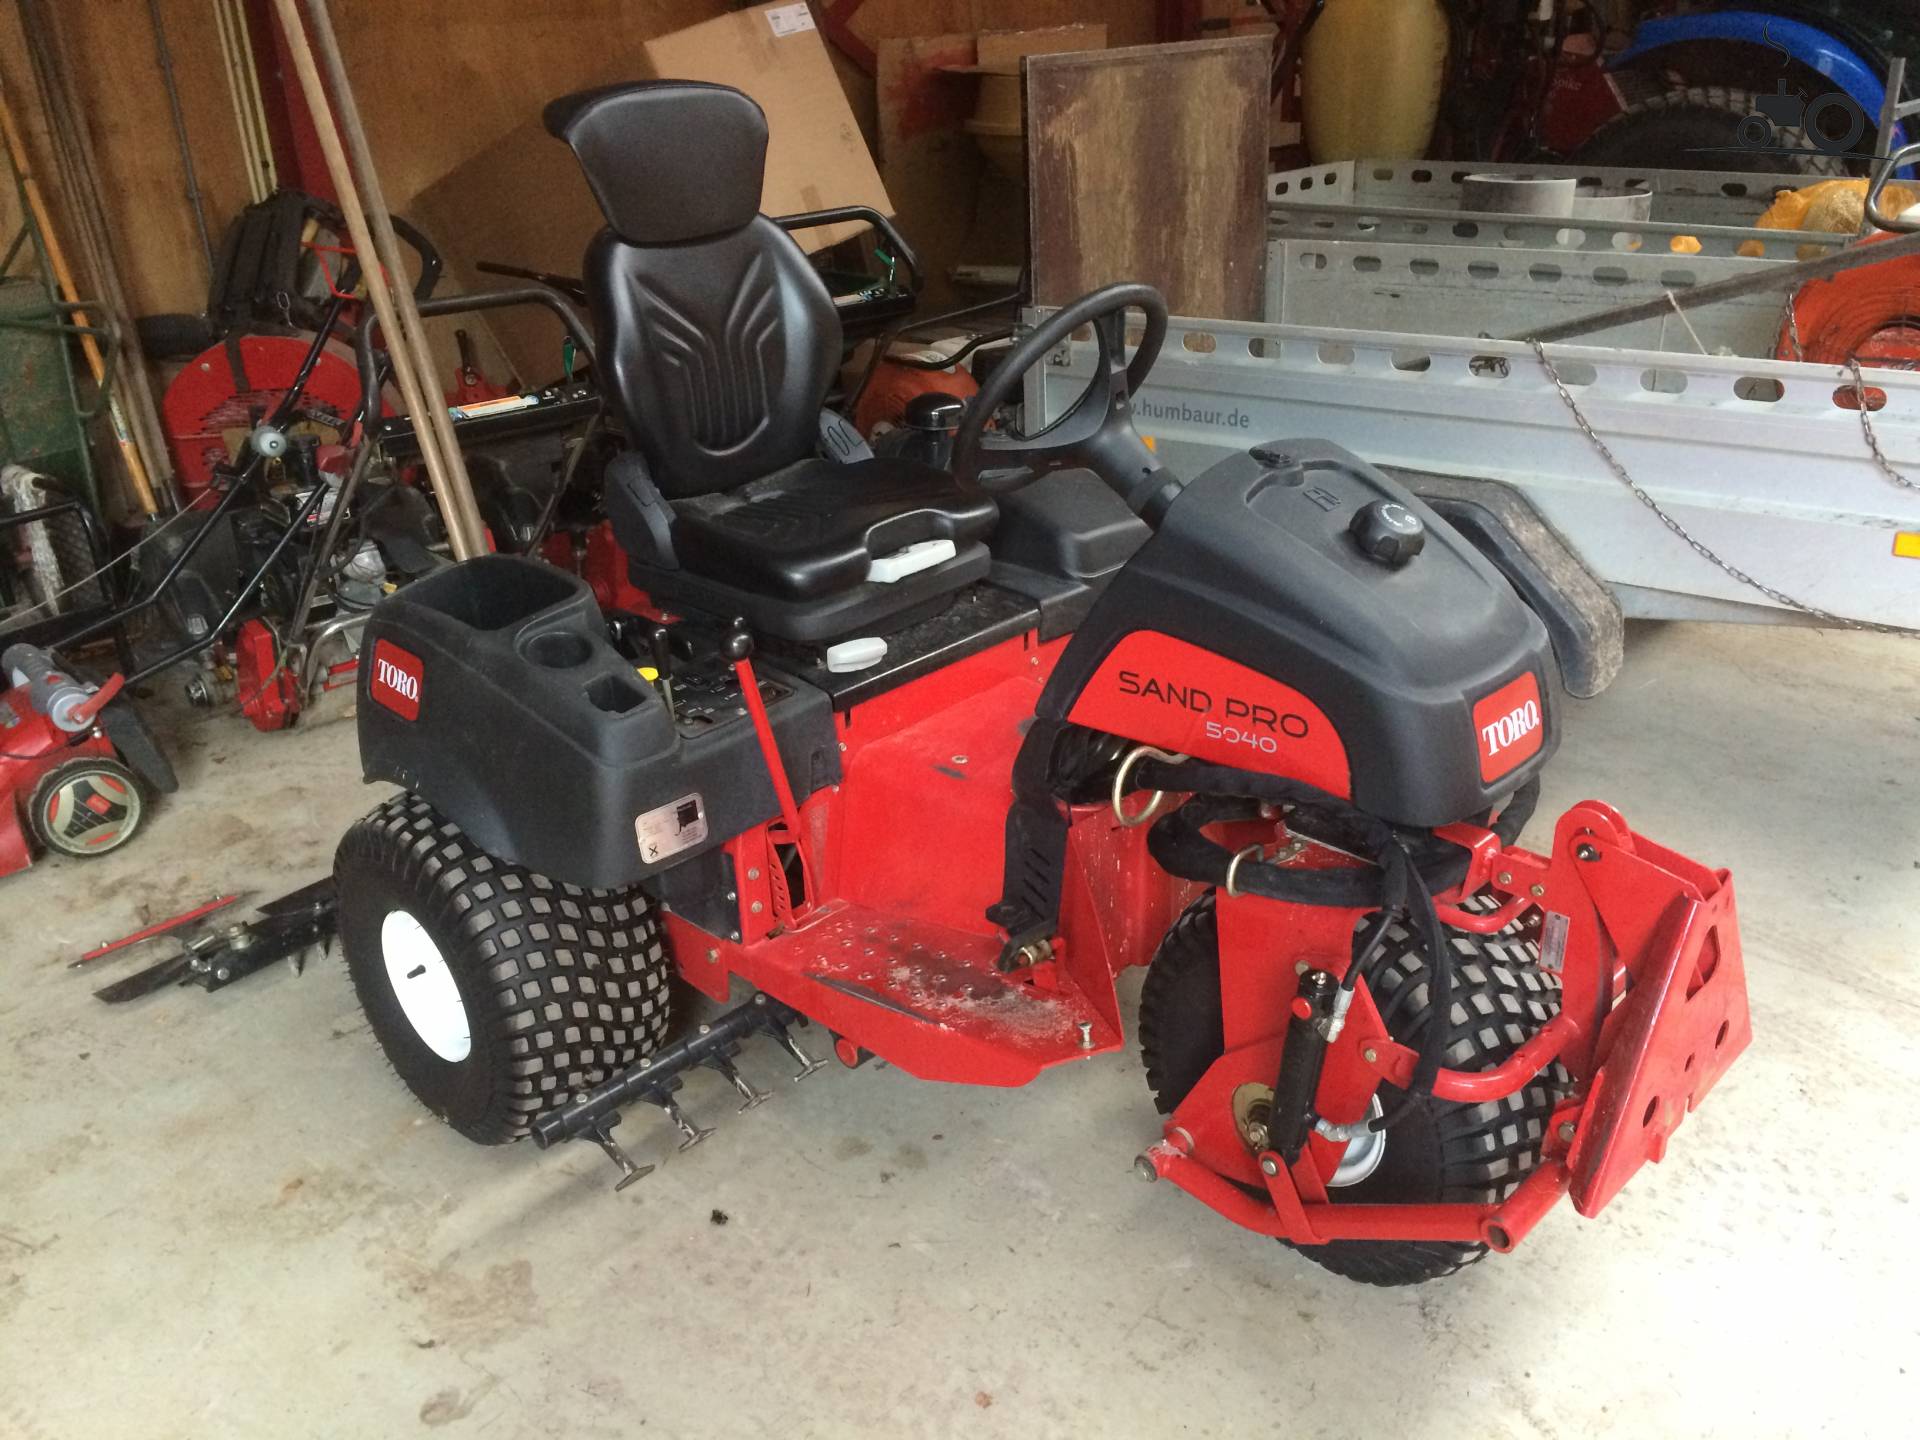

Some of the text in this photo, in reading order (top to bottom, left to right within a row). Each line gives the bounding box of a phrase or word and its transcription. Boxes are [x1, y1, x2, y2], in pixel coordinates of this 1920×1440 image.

[1131, 399, 1249, 428] .humbaur.de
[378, 658, 418, 701] TORO
[1119, 671, 1309, 738] SAND PRO
[1206, 721, 1277, 753] 5040
[1482, 700, 1538, 757] TORO
